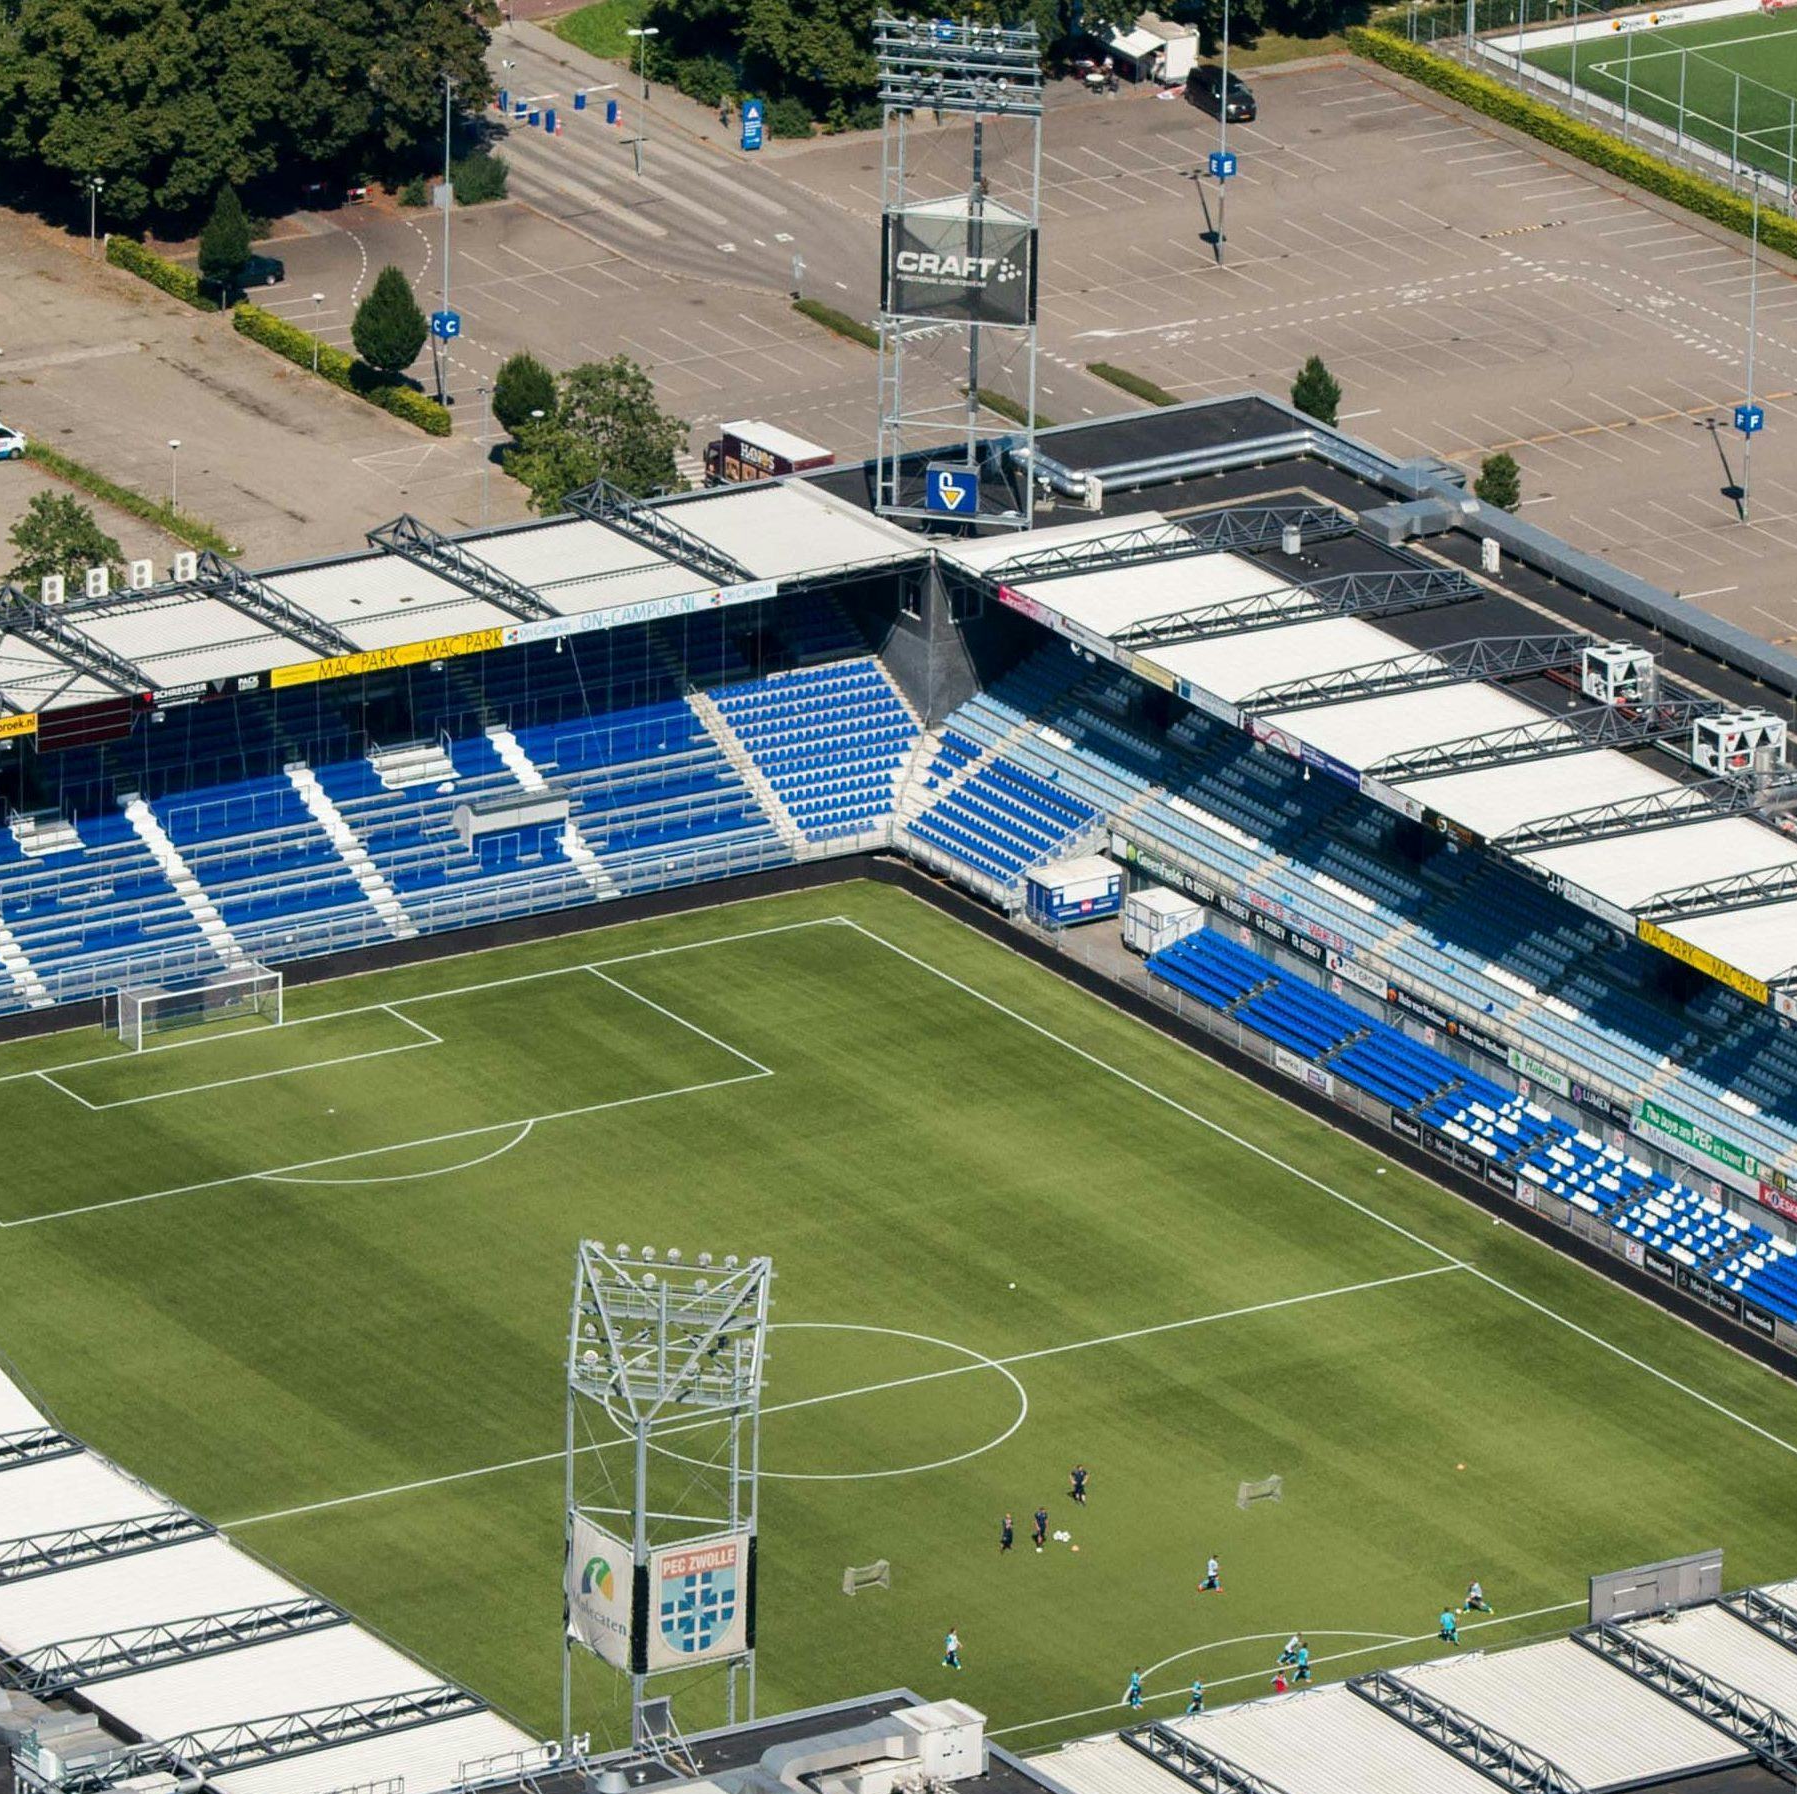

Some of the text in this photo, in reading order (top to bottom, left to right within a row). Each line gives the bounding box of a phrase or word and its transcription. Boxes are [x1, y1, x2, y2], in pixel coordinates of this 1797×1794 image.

[1223, 161, 1233, 173] E
[896, 250, 996, 278] CRAFT
[445, 319, 457, 333] C
[1751, 416, 1760, 428] F
[580, 596, 696, 630] ON-CAMPUS.NL
[1692, 1126, 1714, 1152] PEC
[663, 1548, 735, 1576] PEC ZWOLLE
